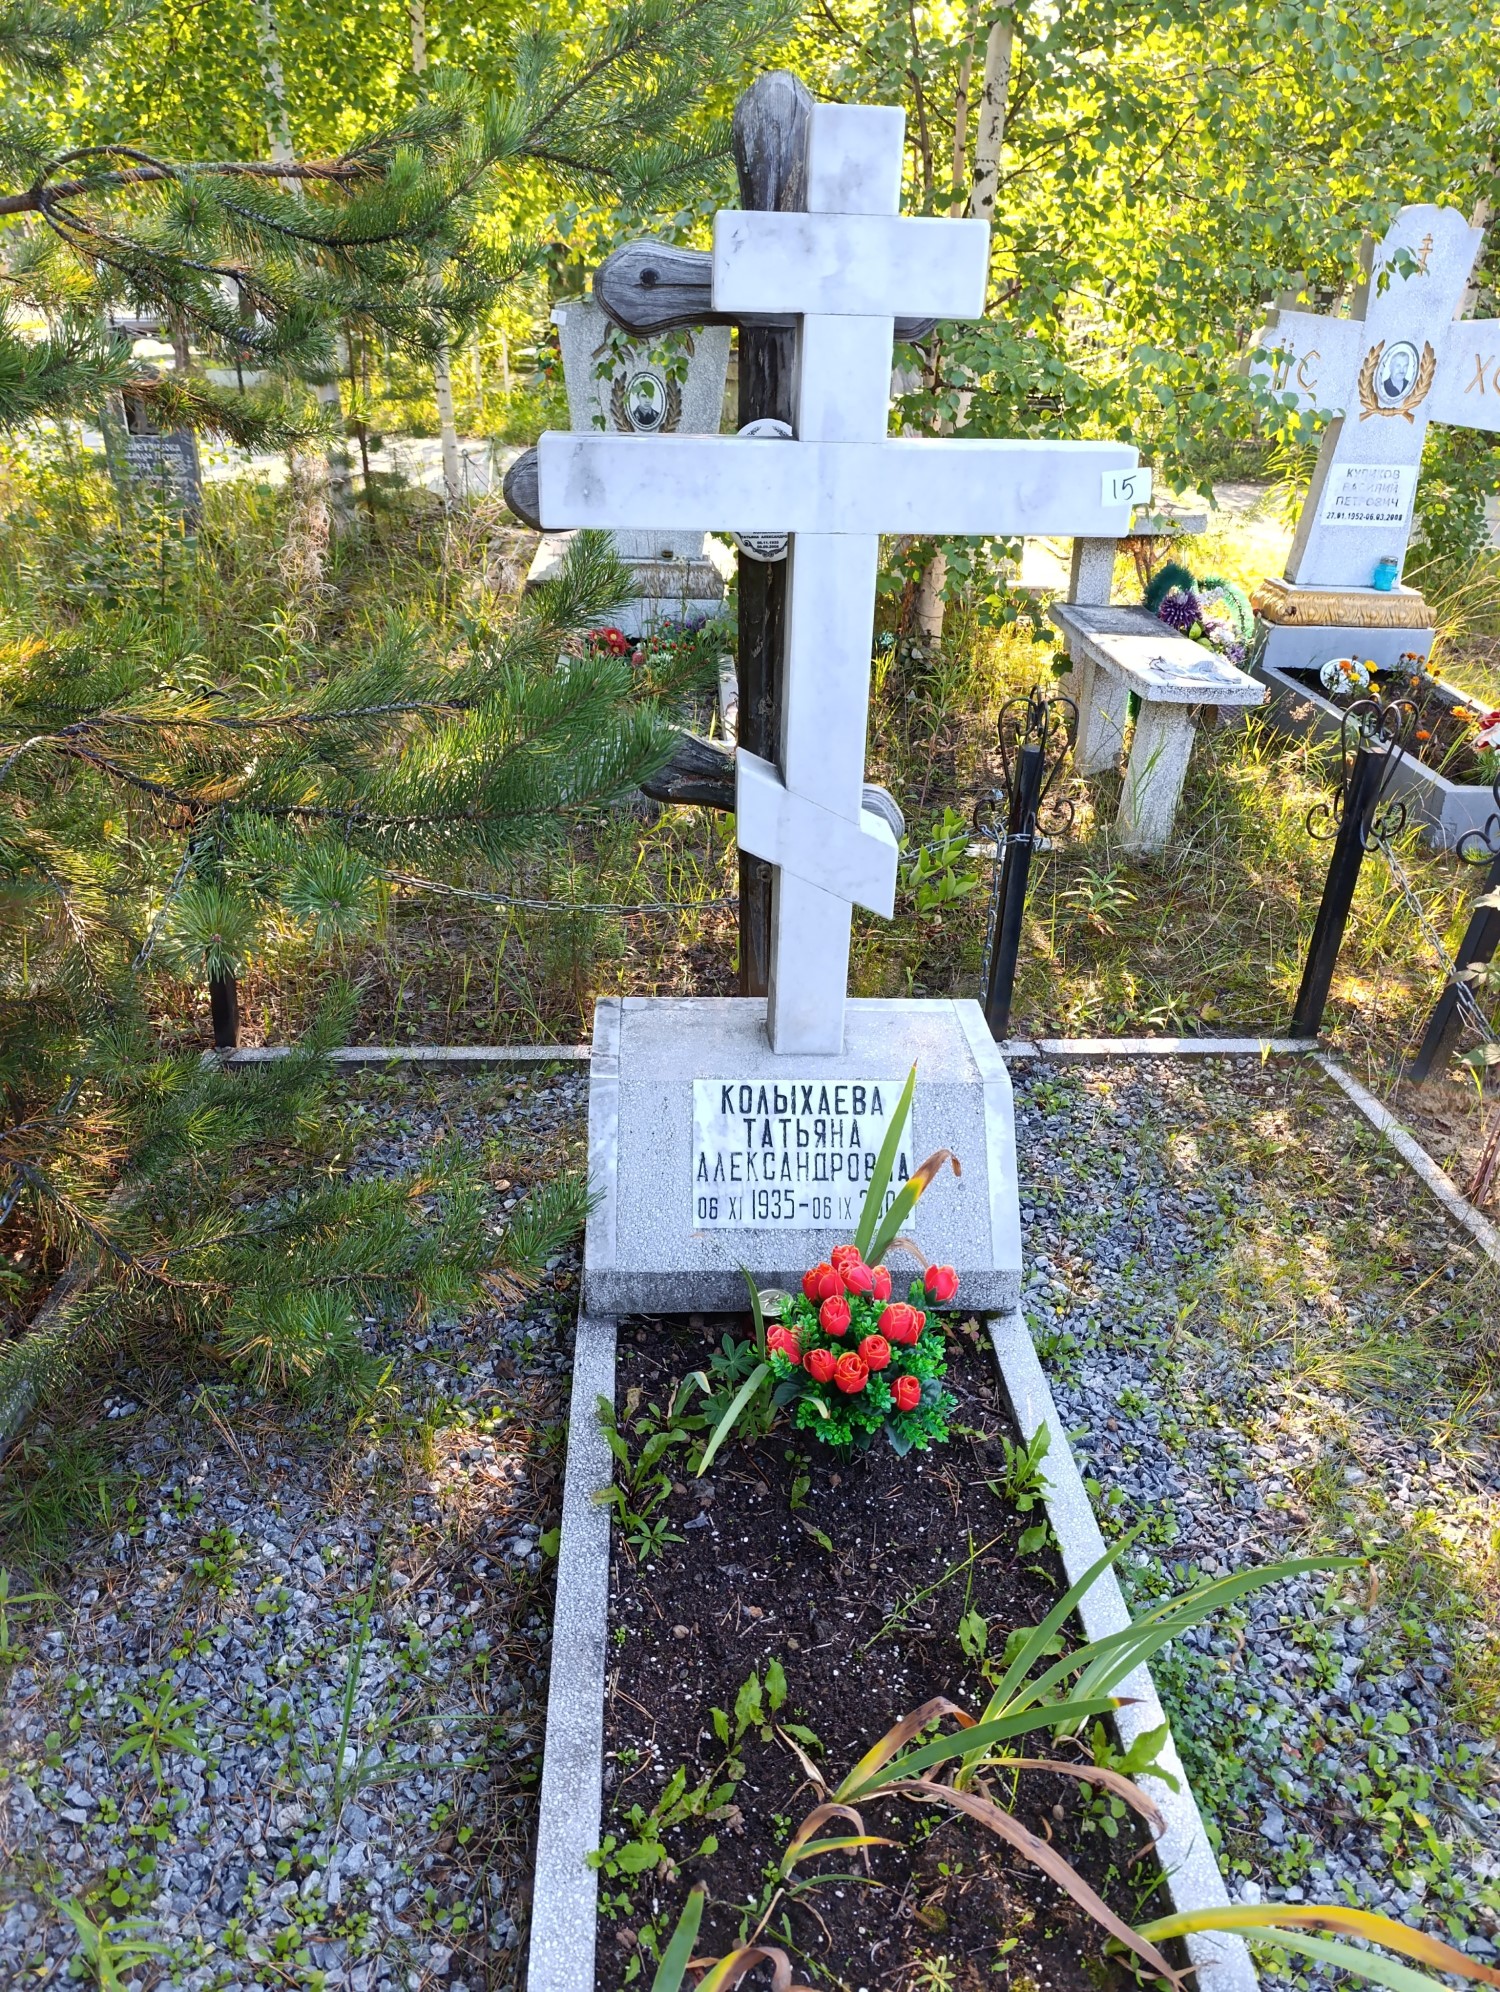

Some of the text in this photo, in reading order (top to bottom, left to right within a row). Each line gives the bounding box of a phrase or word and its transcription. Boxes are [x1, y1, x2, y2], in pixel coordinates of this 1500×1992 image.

[1112, 475, 1137, 501] 15
[1342, 482, 1399, 494] ВАИЛИЙ
[721, 1084, 884, 1116] КОЛЫХАЕВА
[743, 1118, 861, 1149] ТАТЬЯНА
[696, 1152, 910, 1182] АЛЕКСАНДРОВА
[697, 1196, 718, 1220] 06
